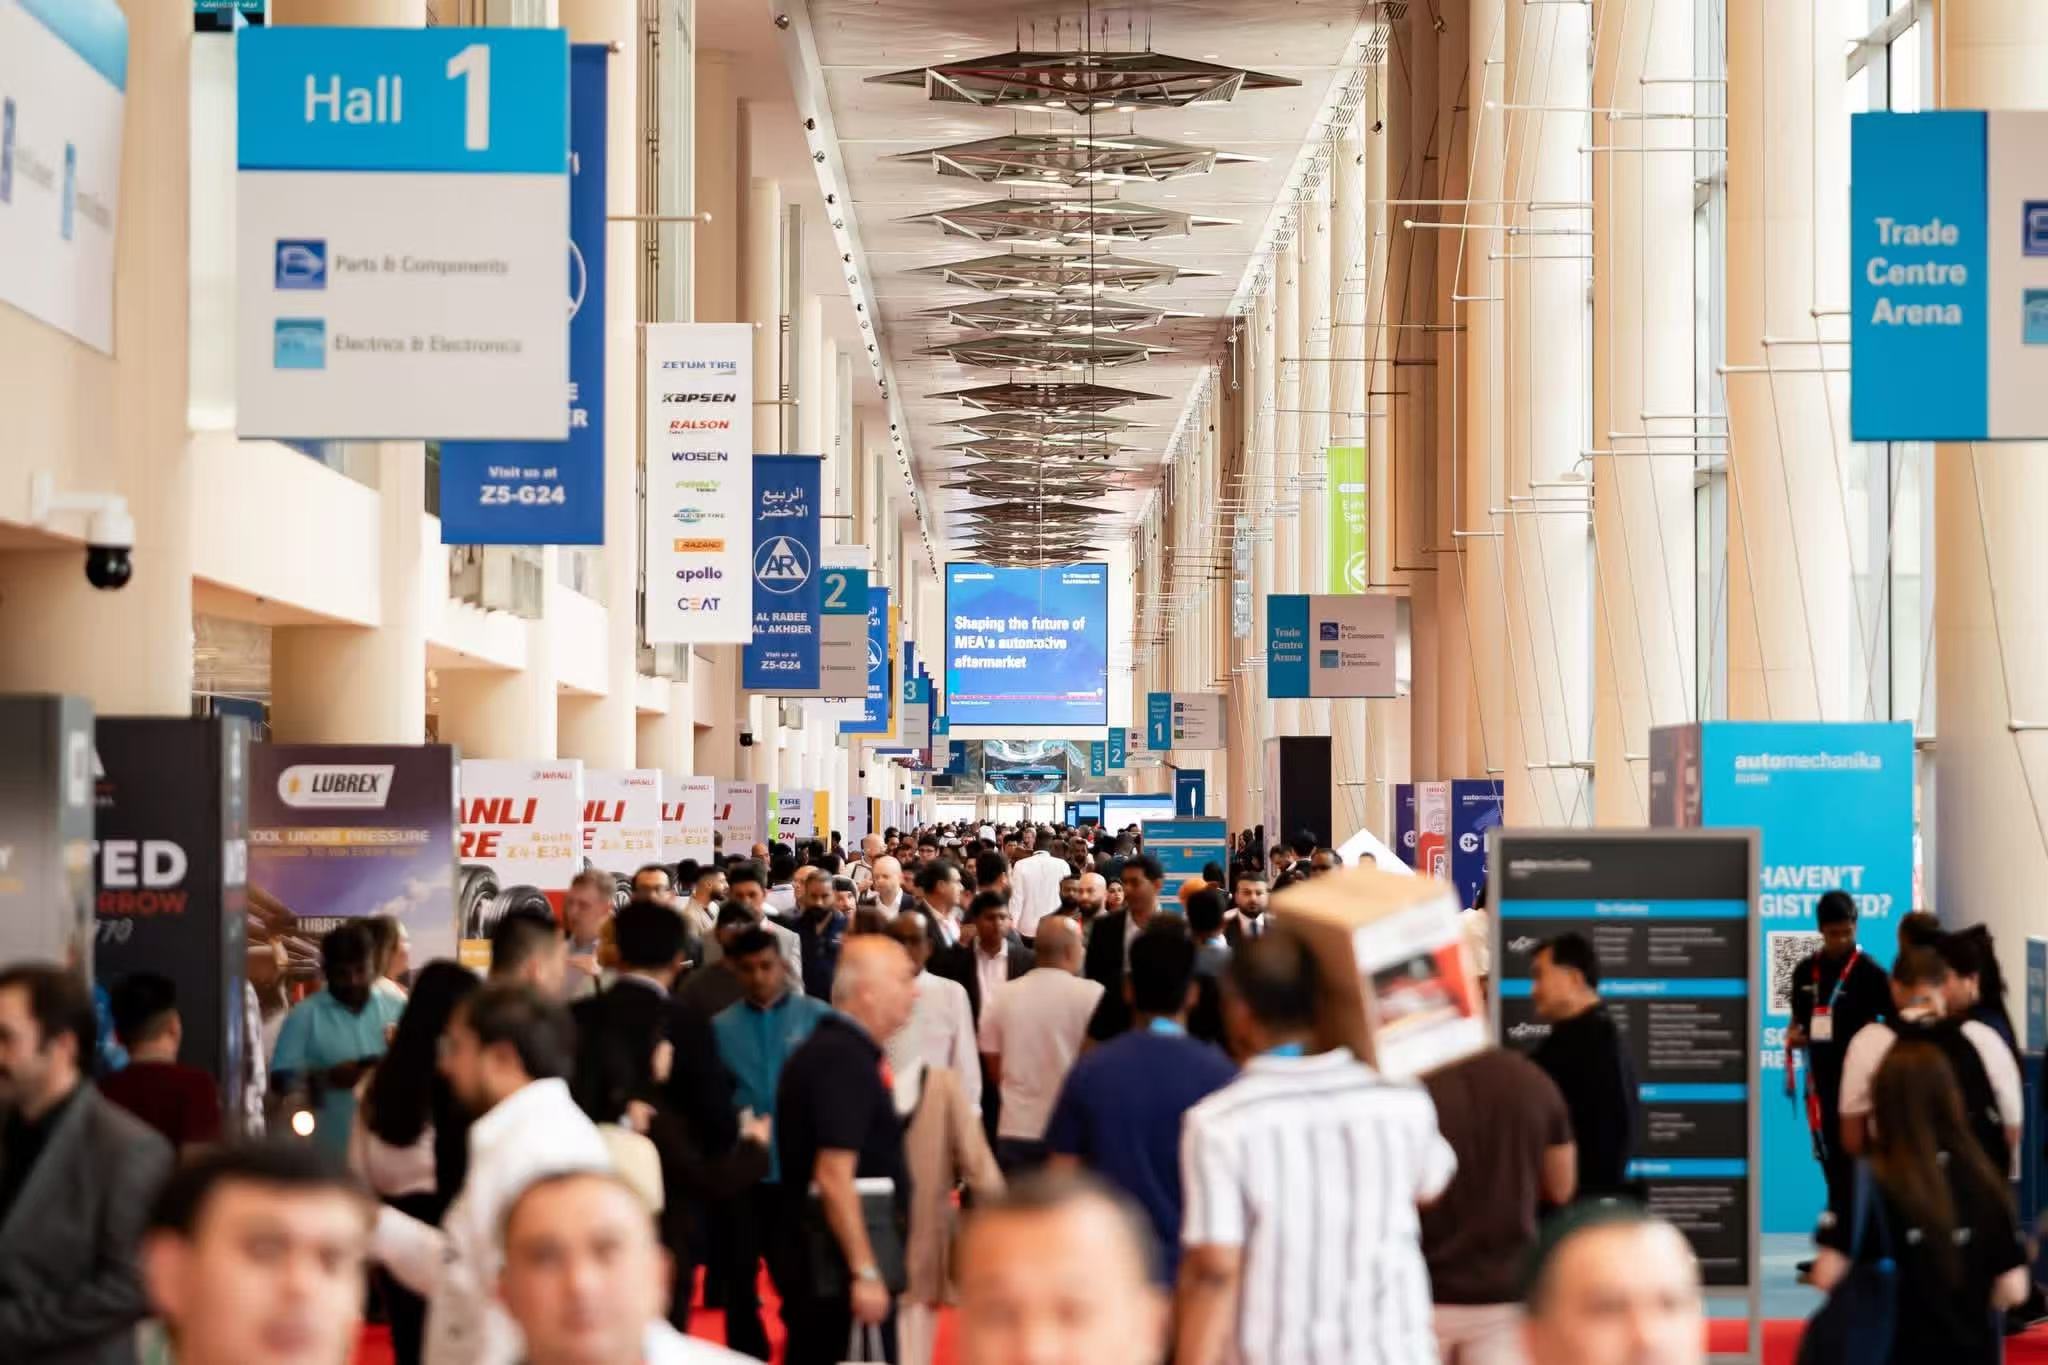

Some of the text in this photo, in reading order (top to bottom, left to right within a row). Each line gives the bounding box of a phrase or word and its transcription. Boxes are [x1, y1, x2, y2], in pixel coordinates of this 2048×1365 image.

[305, 44, 490, 150] Hall 1
[1875, 217, 1958, 246] Trade
[335, 255, 377, 272] Parts
[402, 256, 508, 277] Components
[1866, 257, 1967, 286] Centre
[1871, 298, 1962, 325] Arena
[662, 361, 737, 369] ZETUM TIRE
[670, 420, 730, 429] RALSON
[671, 452, 728, 461] WOSEN
[488, 465, 520, 479] Visit
[480, 485, 566, 504] Z5-G24
[676, 567, 723, 583] apollo
[824, 573, 848, 608] 2
[677, 597, 721, 611] CEAT
[756, 612, 808, 621] AL RABEE
[953, 615, 1086, 632] Shaping the future of
[768, 625, 812, 633] AKHDER
[1275, 628, 1301, 638] Trade
[954, 635, 1068, 650] MEA's automotive
[1272, 640, 1304, 650] Centre
[954, 655, 1028, 669] aftermarket
[1273, 653, 1302, 662] Arena
[761, 661, 801, 670] Z5-G24
[904, 681, 917, 700] 3
[931, 718, 940, 733] 4
[1154, 722, 1164, 743] 1
[1111, 748, 1121, 763] 2
[1734, 751, 1882, 769] automechanika
[1093, 759, 1103, 772] 3
[311, 774, 383, 793] LUBREX
[345, 829, 432, 843] PRESSURE
